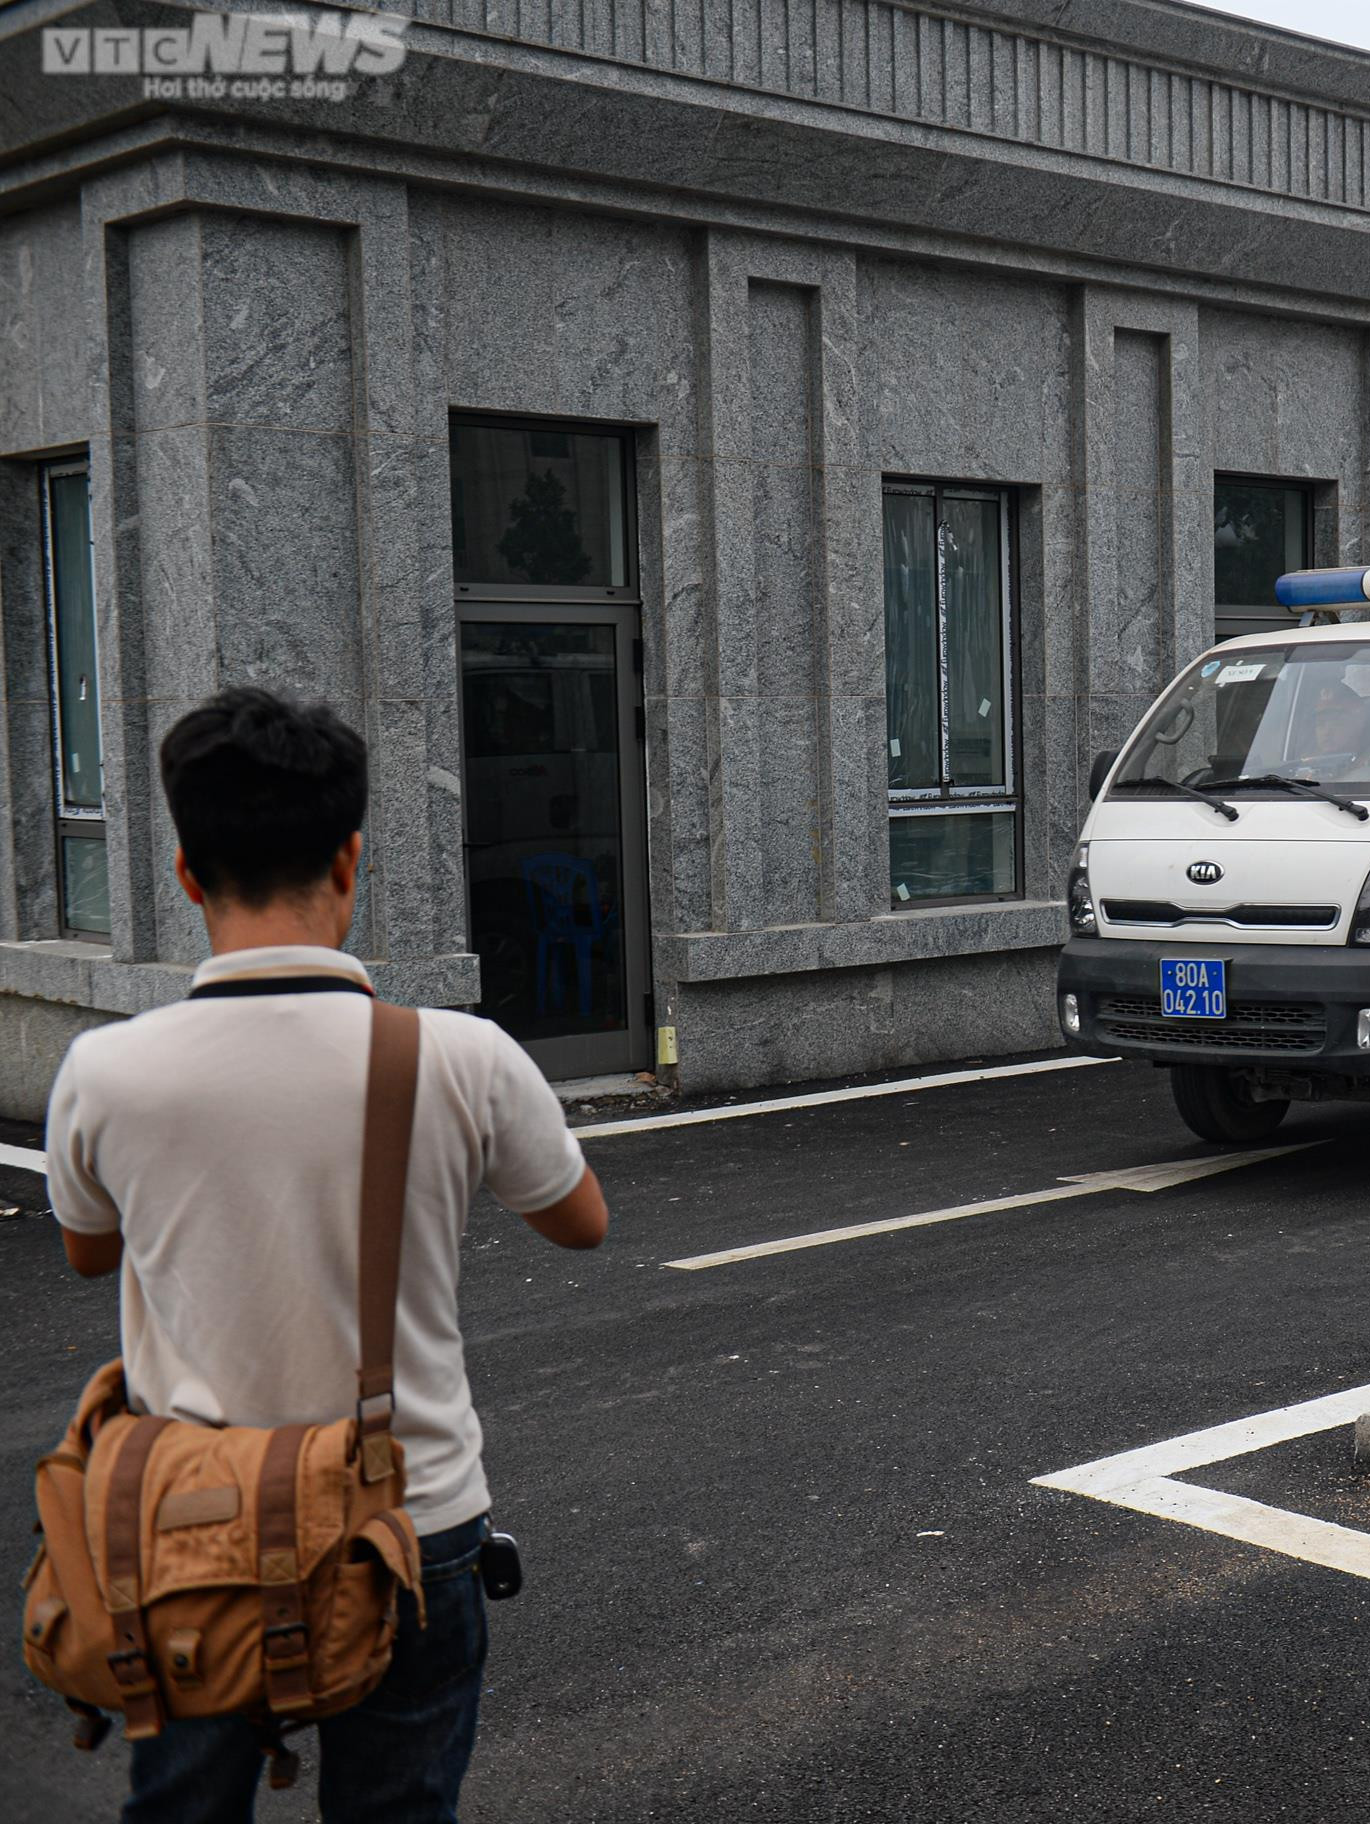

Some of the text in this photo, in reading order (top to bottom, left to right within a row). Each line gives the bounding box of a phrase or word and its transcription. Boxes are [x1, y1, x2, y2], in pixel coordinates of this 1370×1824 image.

[1190, 865, 1217, 879] KIA
[1175, 963, 1209, 988] 80A
[1163, 989, 1223, 1015] 042.10
